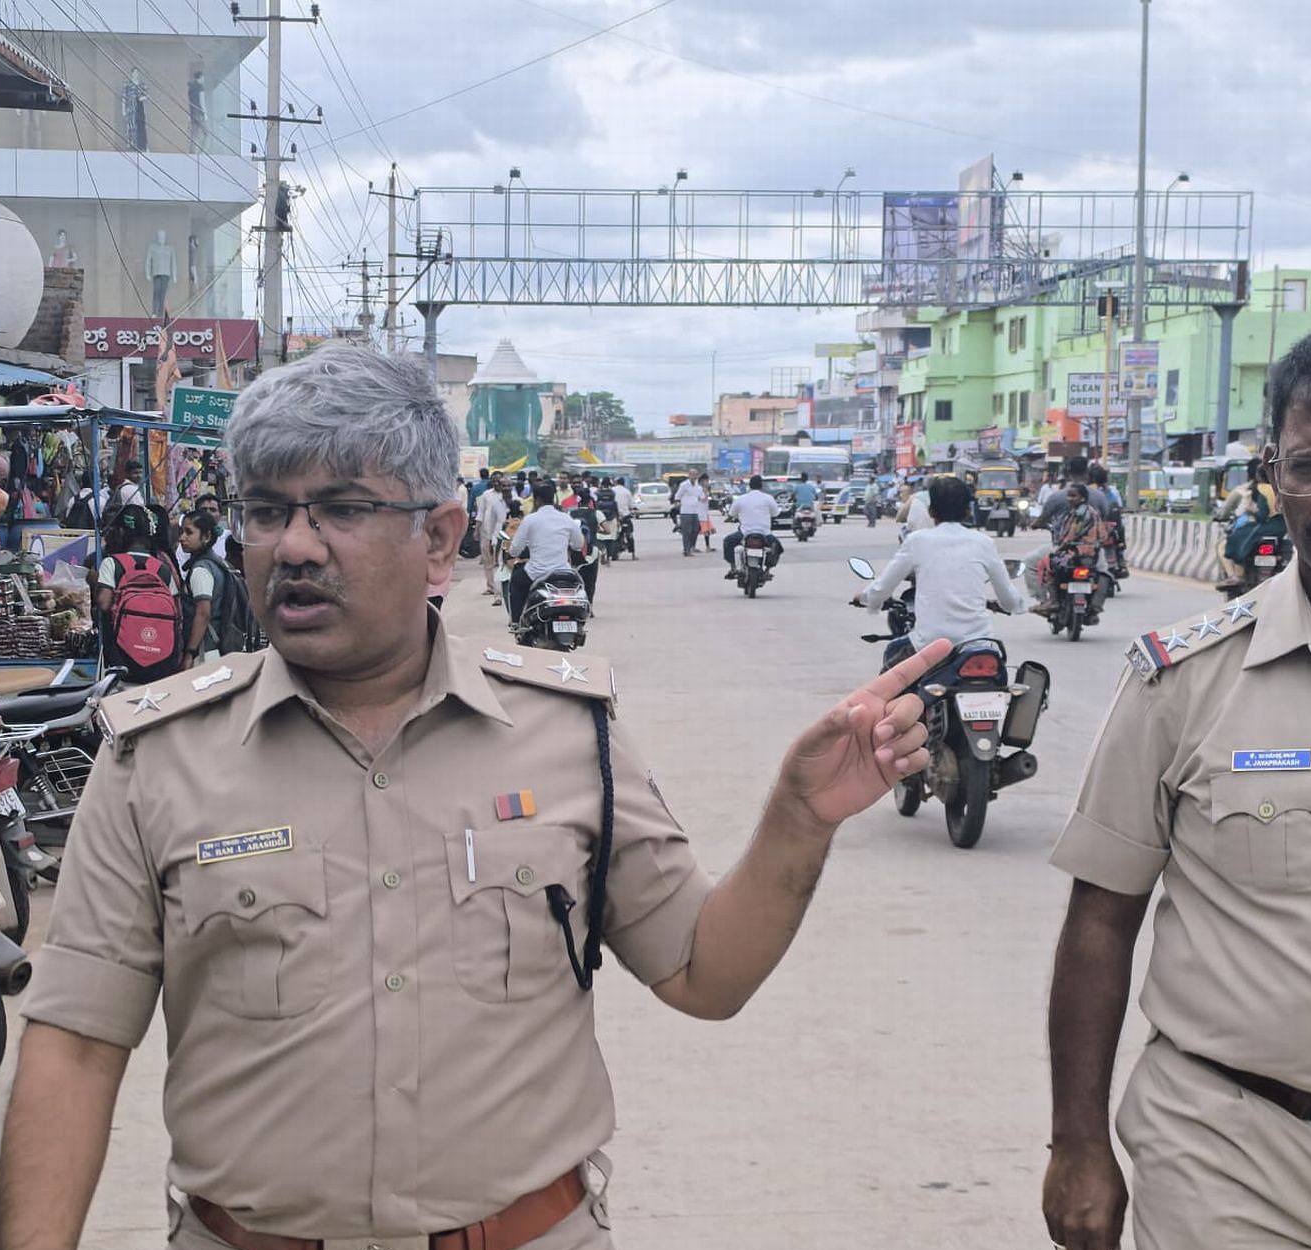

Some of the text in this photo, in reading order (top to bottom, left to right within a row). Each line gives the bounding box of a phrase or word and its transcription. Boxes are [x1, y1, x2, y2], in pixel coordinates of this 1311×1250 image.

[1070, 384, 1101, 393] CLEAN
[1069, 397, 1101, 406] GREEN
[183, 411, 230, 428] Bus Stan
